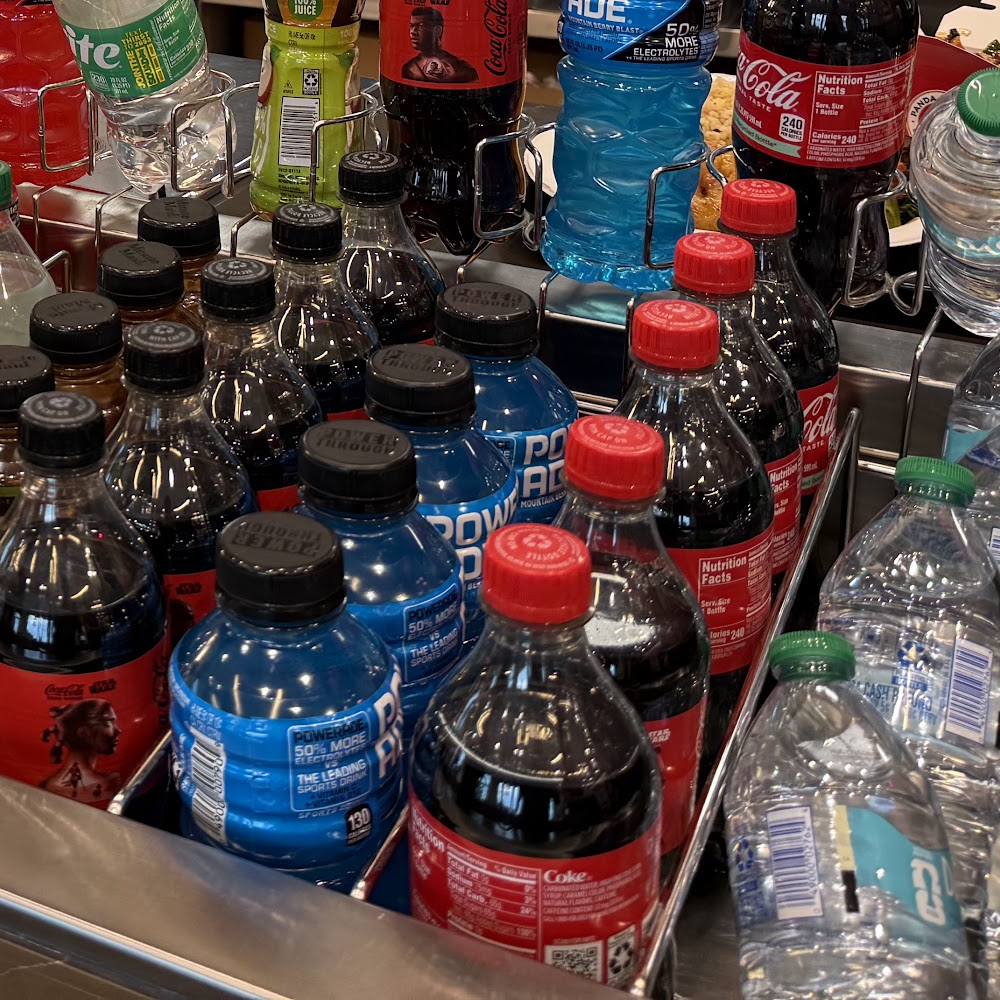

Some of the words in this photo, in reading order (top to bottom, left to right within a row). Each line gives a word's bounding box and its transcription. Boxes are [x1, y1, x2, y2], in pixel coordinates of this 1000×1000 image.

[294, 4, 317, 16] JUICE
[159, 15, 176, 30] Facts
[593, 22, 615, 32] BERRY
[666, 23, 698, 37] 50%
[121, 31, 149, 46] THIRST
[665, 36, 698, 48] MORE
[633, 47, 698, 57] ELECTROLYTES
[818, 74, 863, 85] Nutrition
[817, 84, 846, 95] Facts
[749, 95, 772, 112] TASTE
[911, 94, 937, 117] PANDA
[783, 116, 803, 130] 240
[812, 131, 841, 140] Calories
[841, 135, 857, 144] 240
[769, 462, 798, 482] Nutrition
[520, 495, 555, 508] MOUNTAIN
[702, 556, 747, 573] Nutrition
[701, 573, 732, 585] Facts
[701, 599, 717, 608] Serv.
[707, 606, 726, 615] Bottle
[409, 618, 433, 633] 50%
[731, 626, 745, 640] 240
[410, 646, 428, 658] THE
[431, 627, 459, 650] LEADING
[410, 649, 441, 667] SPORTS
[45, 683, 85, 697] Coca-Cola
[294, 718, 364, 743] POWERADE
[295, 743, 326, 757] 50%
[330, 732, 367, 751] MORE
[295, 743, 367, 765] ELECTROLYTES
[297, 773, 320, 786] THE
[323, 759, 367, 782] LEADING
[297, 780, 336, 794] SPORTS
[339, 770, 367, 787] DRINK
[348, 808, 370, 828] 130
[411, 807, 445, 852] Nutrition
[448, 858, 465, 873] Total
[466, 867, 479, 879] Fat
[525, 885, 537, 893] 0%
[502, 866, 518, 877] Daily
[520, 869, 537, 879] Value
[543, 870, 588, 883] Coke
[448, 868, 473, 887] Sodium
[525, 895, 537, 904] 3%
[448, 878, 465, 893] Total
[466, 888, 487, 903] Carb.
[520, 906, 537, 915] 24%
[448, 910, 473, 931] Protein
